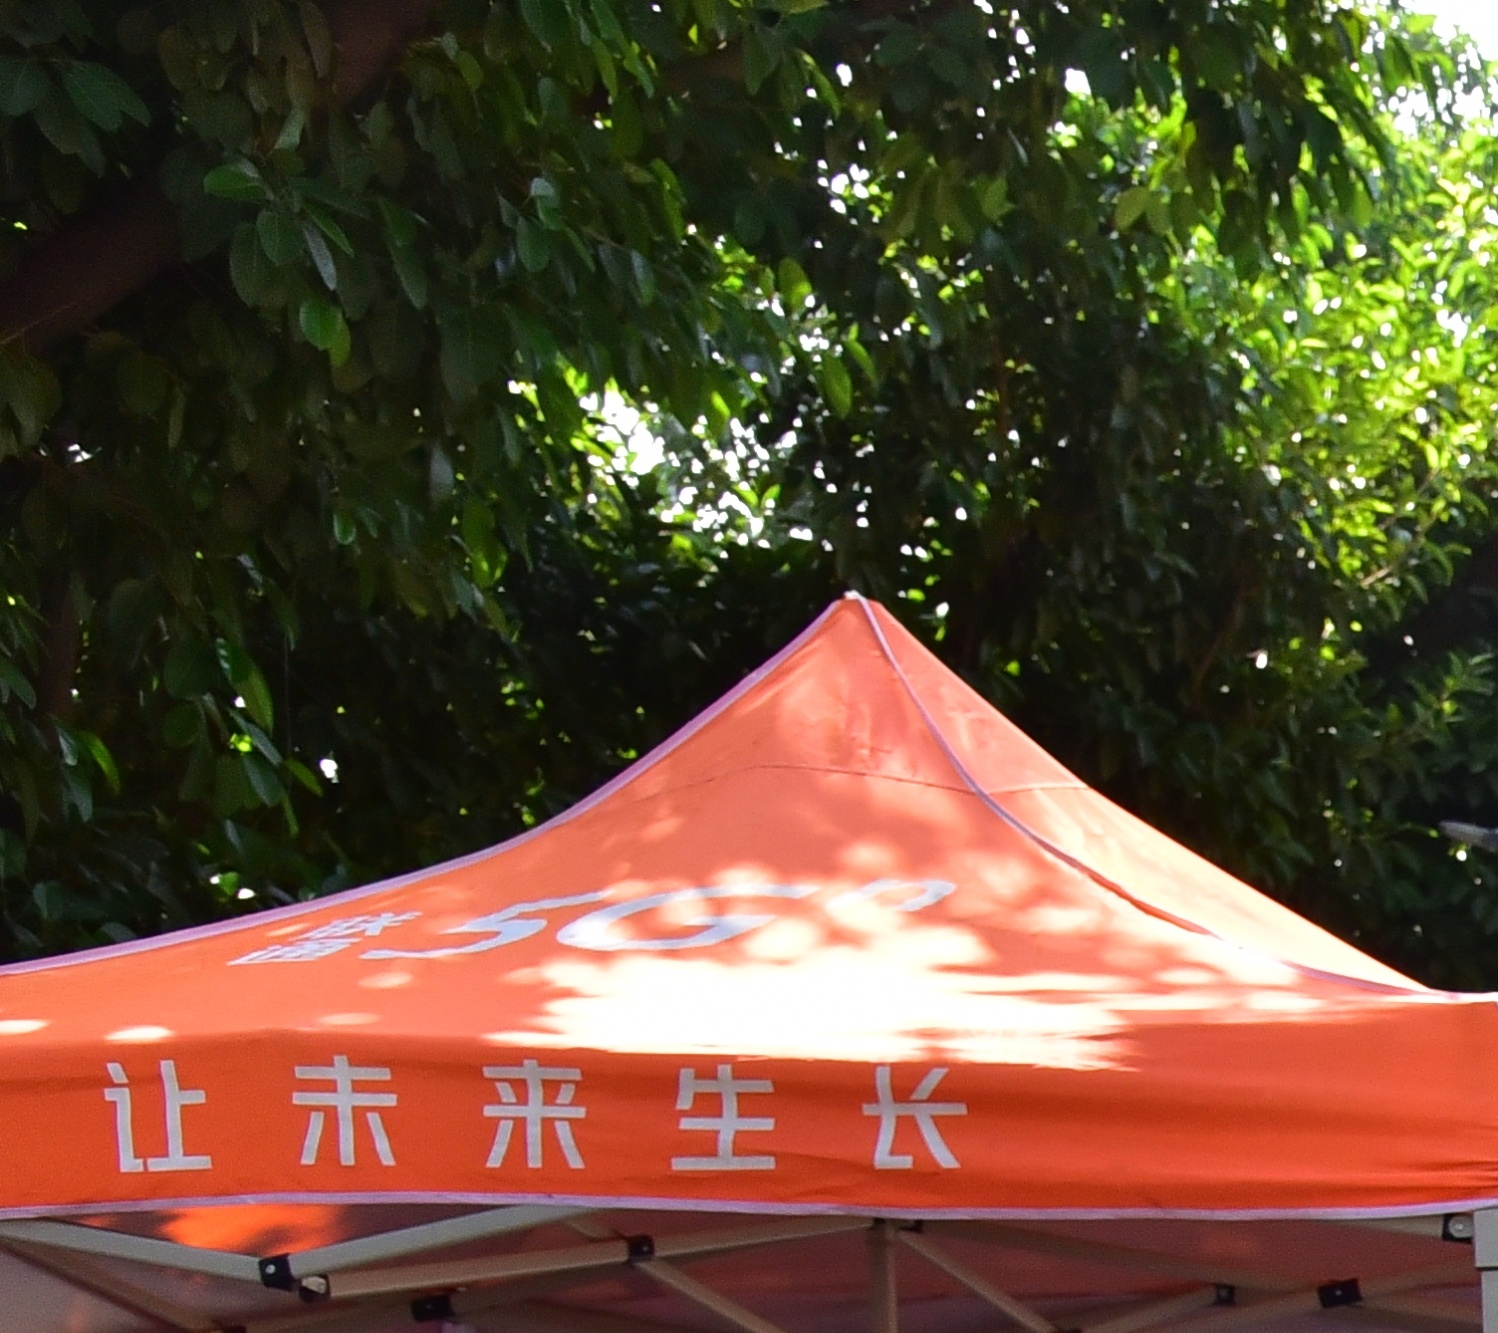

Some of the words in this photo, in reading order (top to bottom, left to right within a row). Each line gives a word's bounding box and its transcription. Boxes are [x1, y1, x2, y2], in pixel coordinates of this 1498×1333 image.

[103, 1053, 968, 1174] 让未来生长
